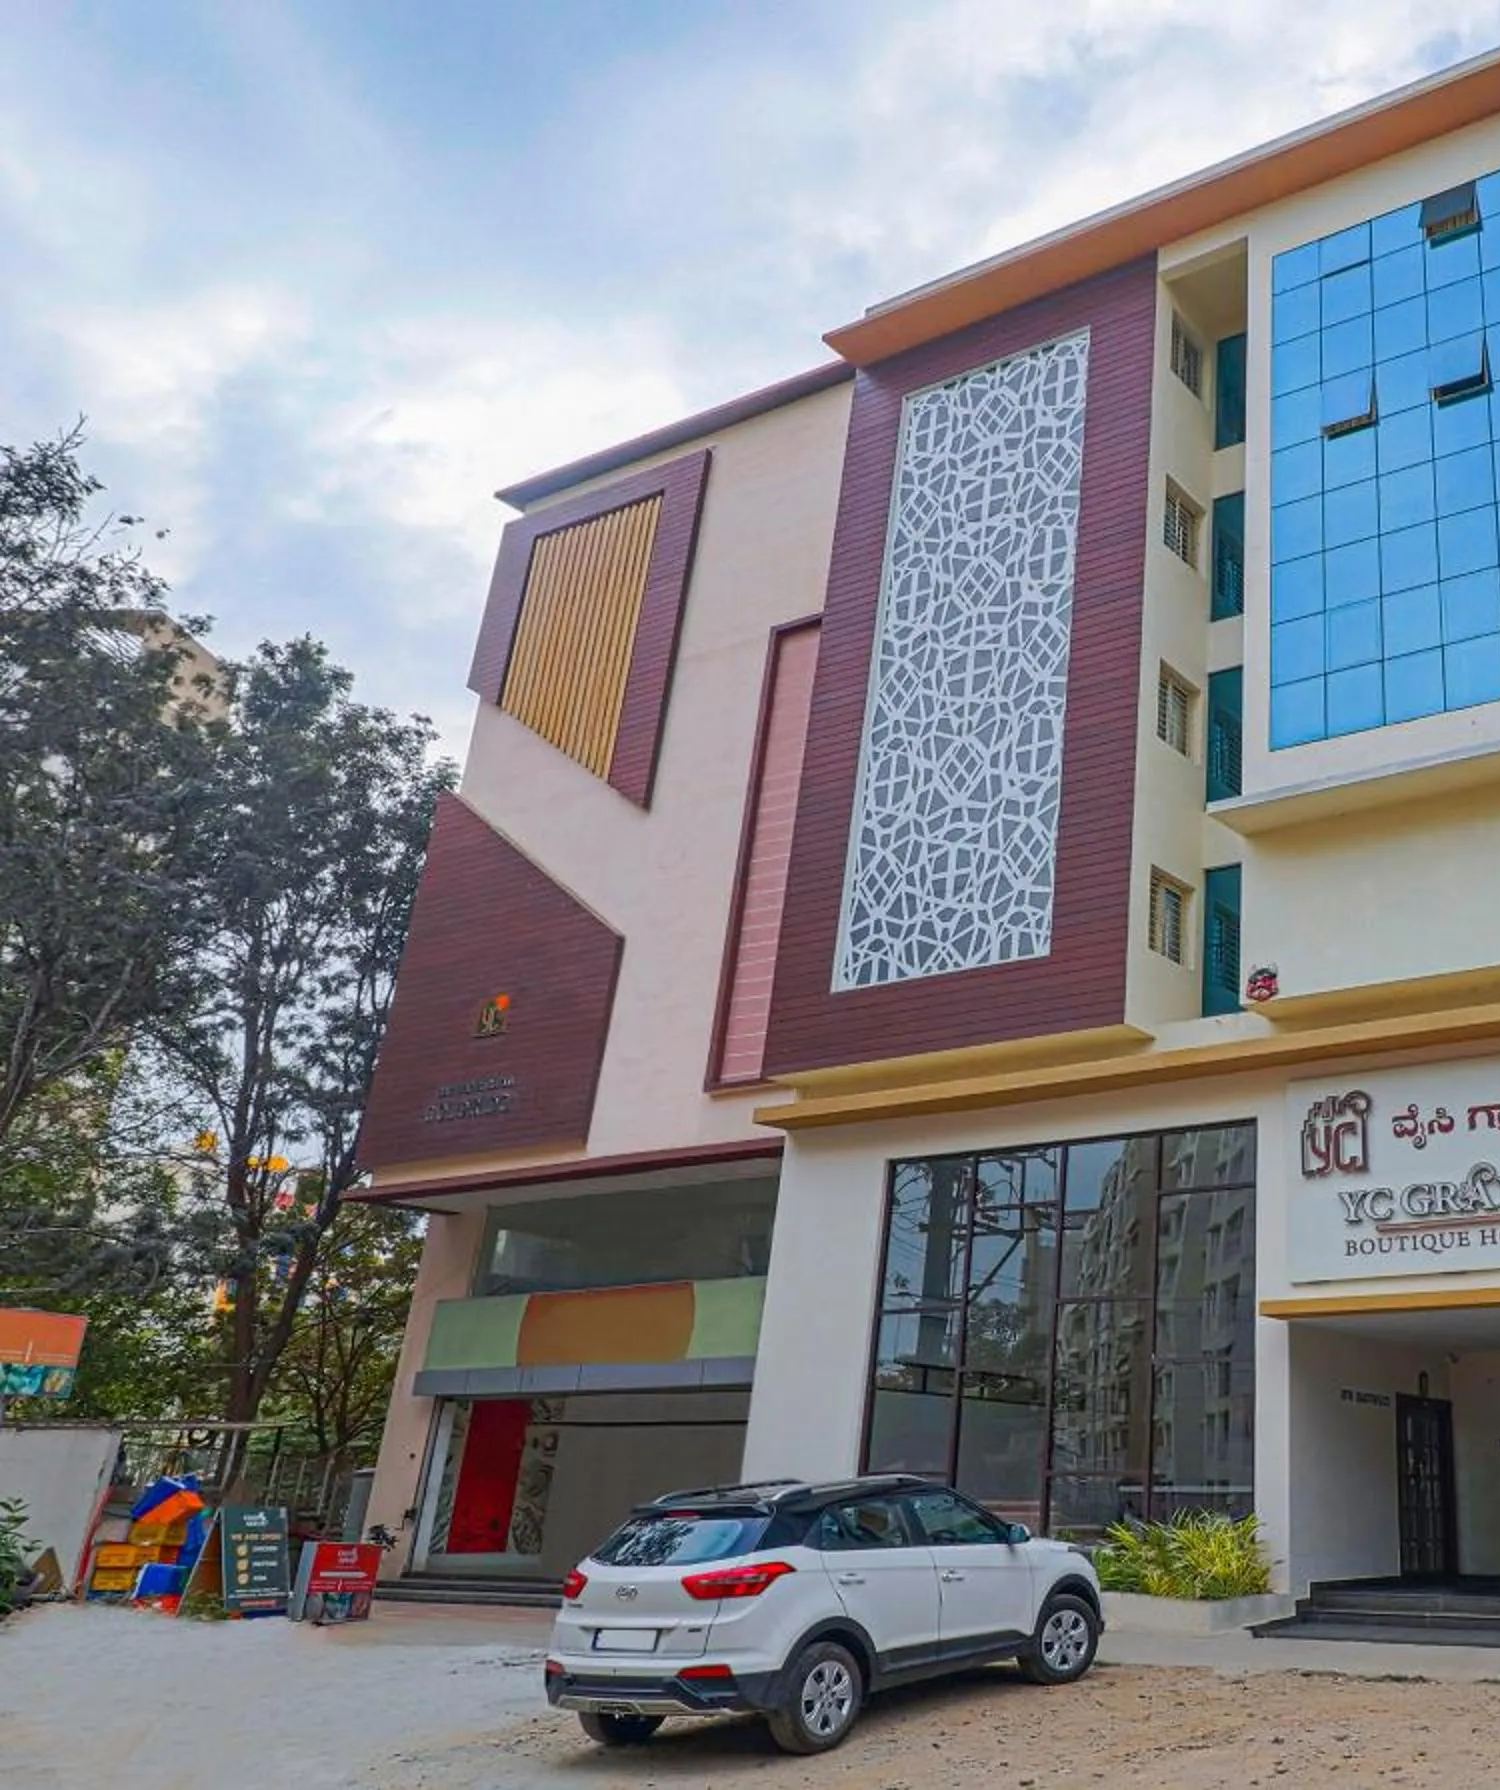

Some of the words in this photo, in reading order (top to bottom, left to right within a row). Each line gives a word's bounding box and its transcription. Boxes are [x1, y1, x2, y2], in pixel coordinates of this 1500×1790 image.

[1391, 1103, 1455, 1149] ವೈಸಿ
[1338, 1187, 1394, 1224] YC
[1344, 1231, 1471, 1257] BOUTIQUE
